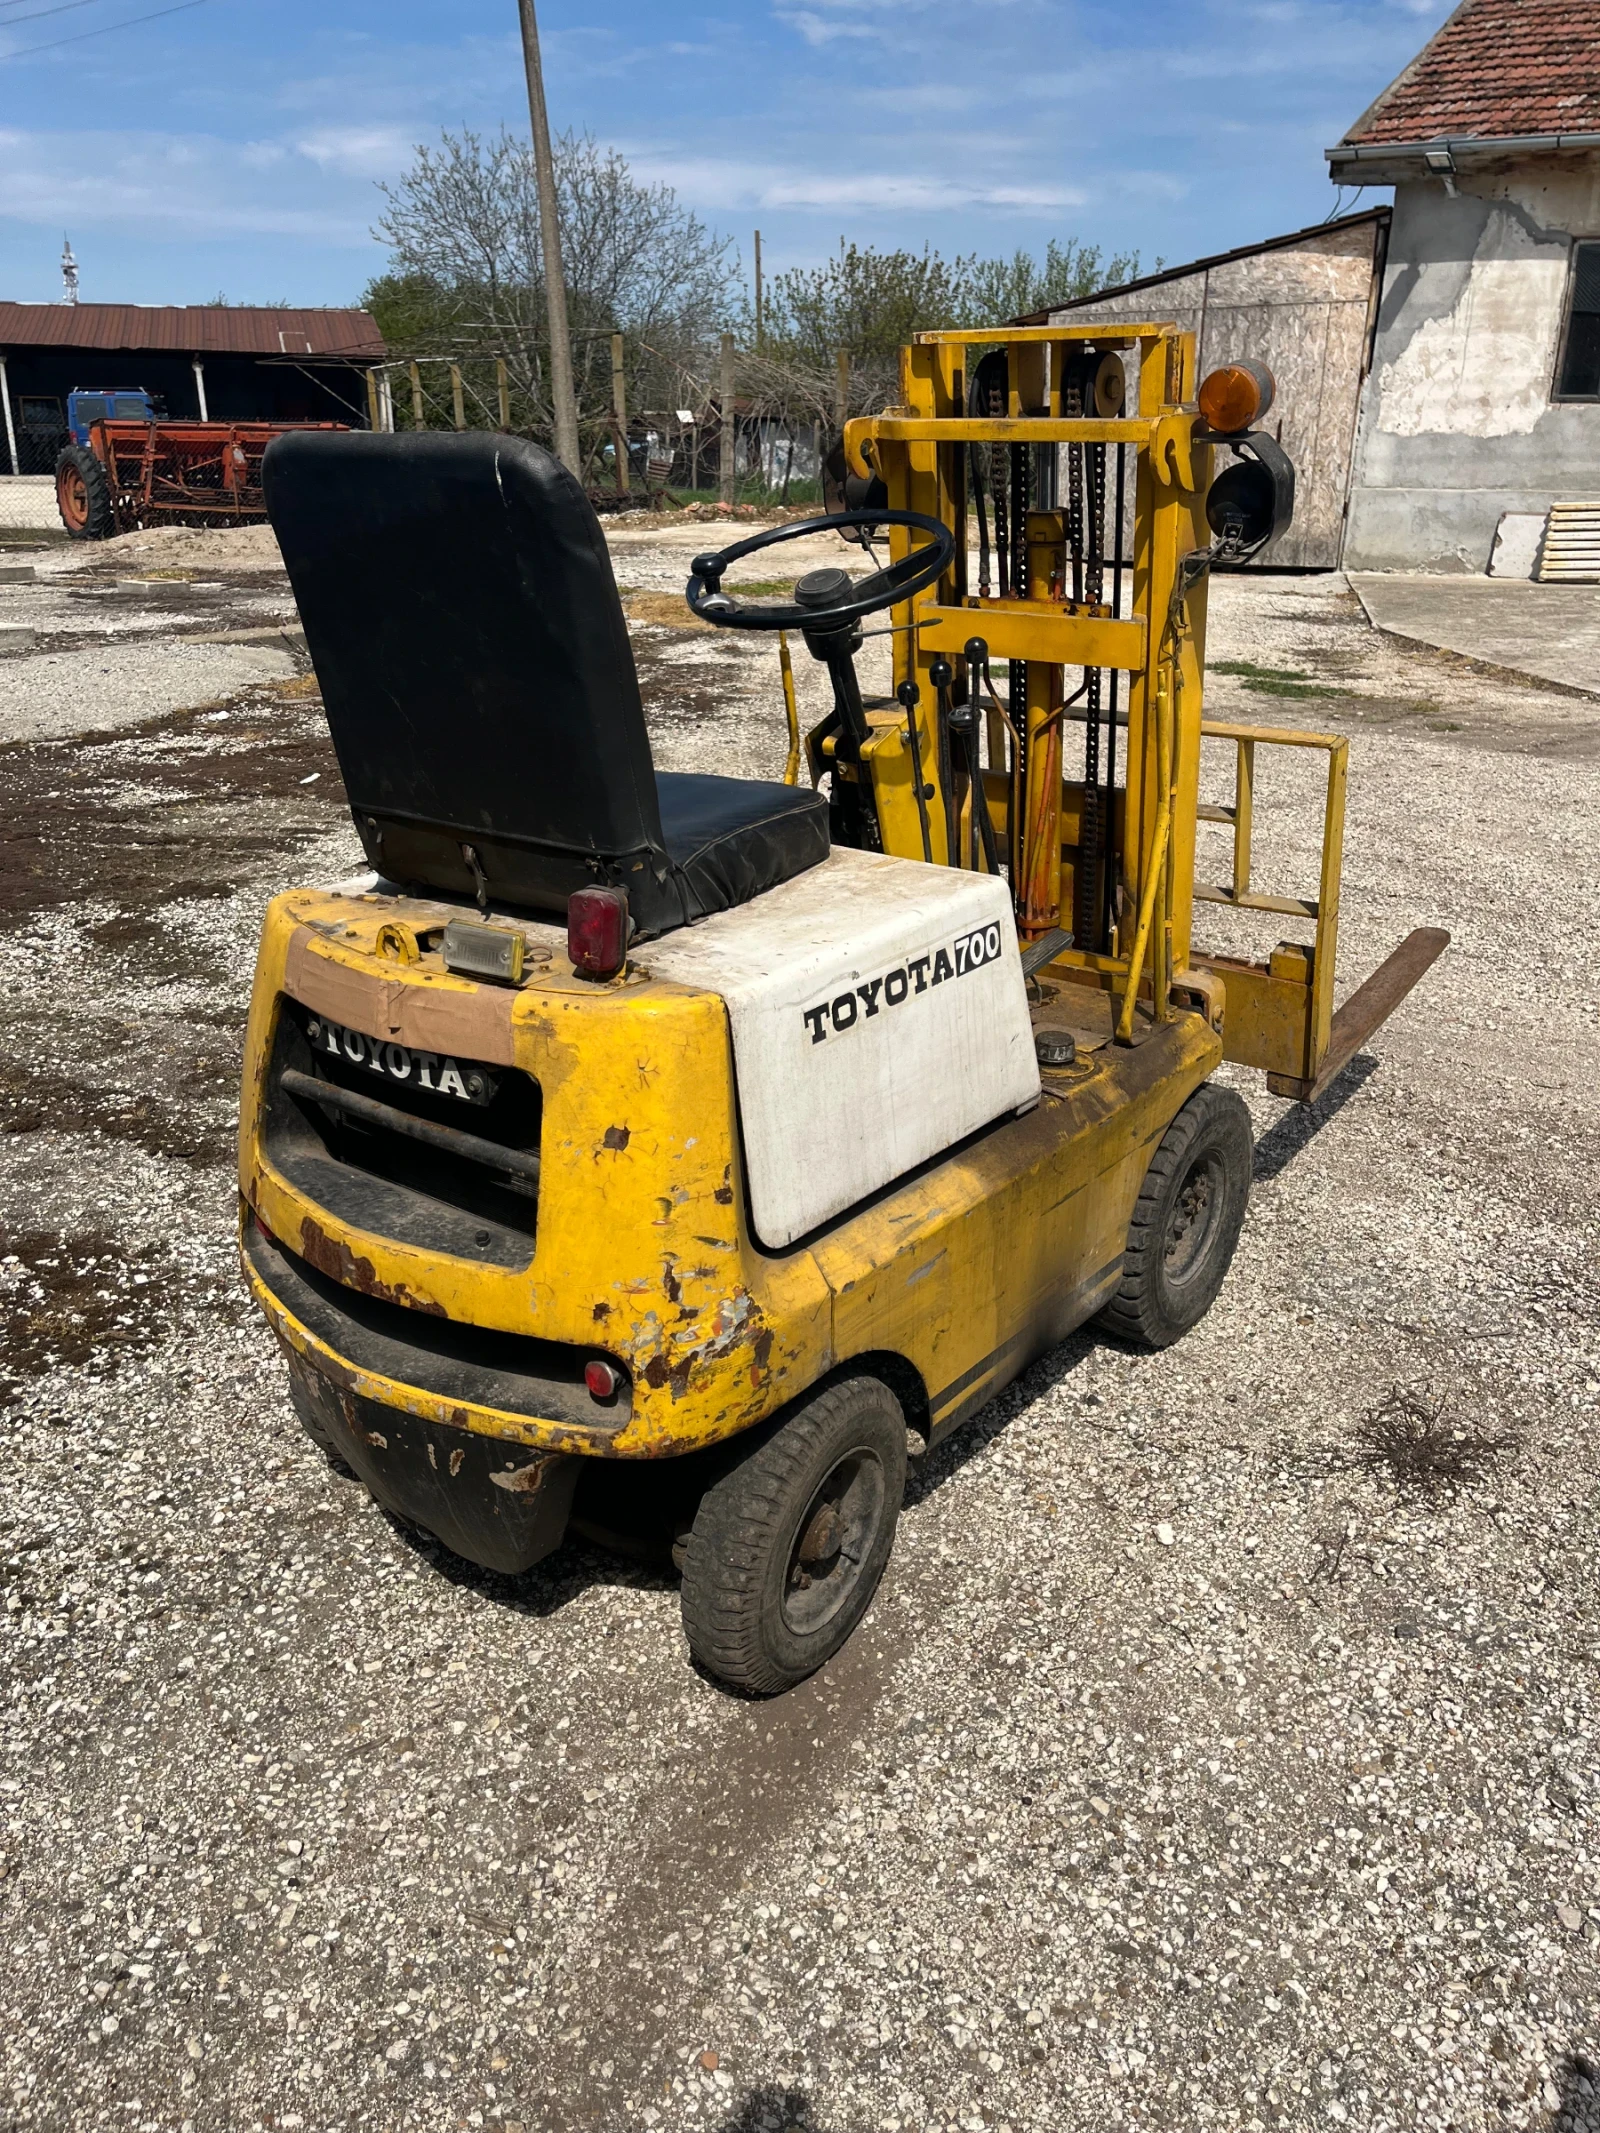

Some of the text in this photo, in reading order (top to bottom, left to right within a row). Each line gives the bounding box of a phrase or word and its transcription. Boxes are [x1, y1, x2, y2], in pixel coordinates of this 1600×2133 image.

[803, 925, 1000, 1045] TOYOTA 700
[320, 1017, 470, 1100] TOYOTA
